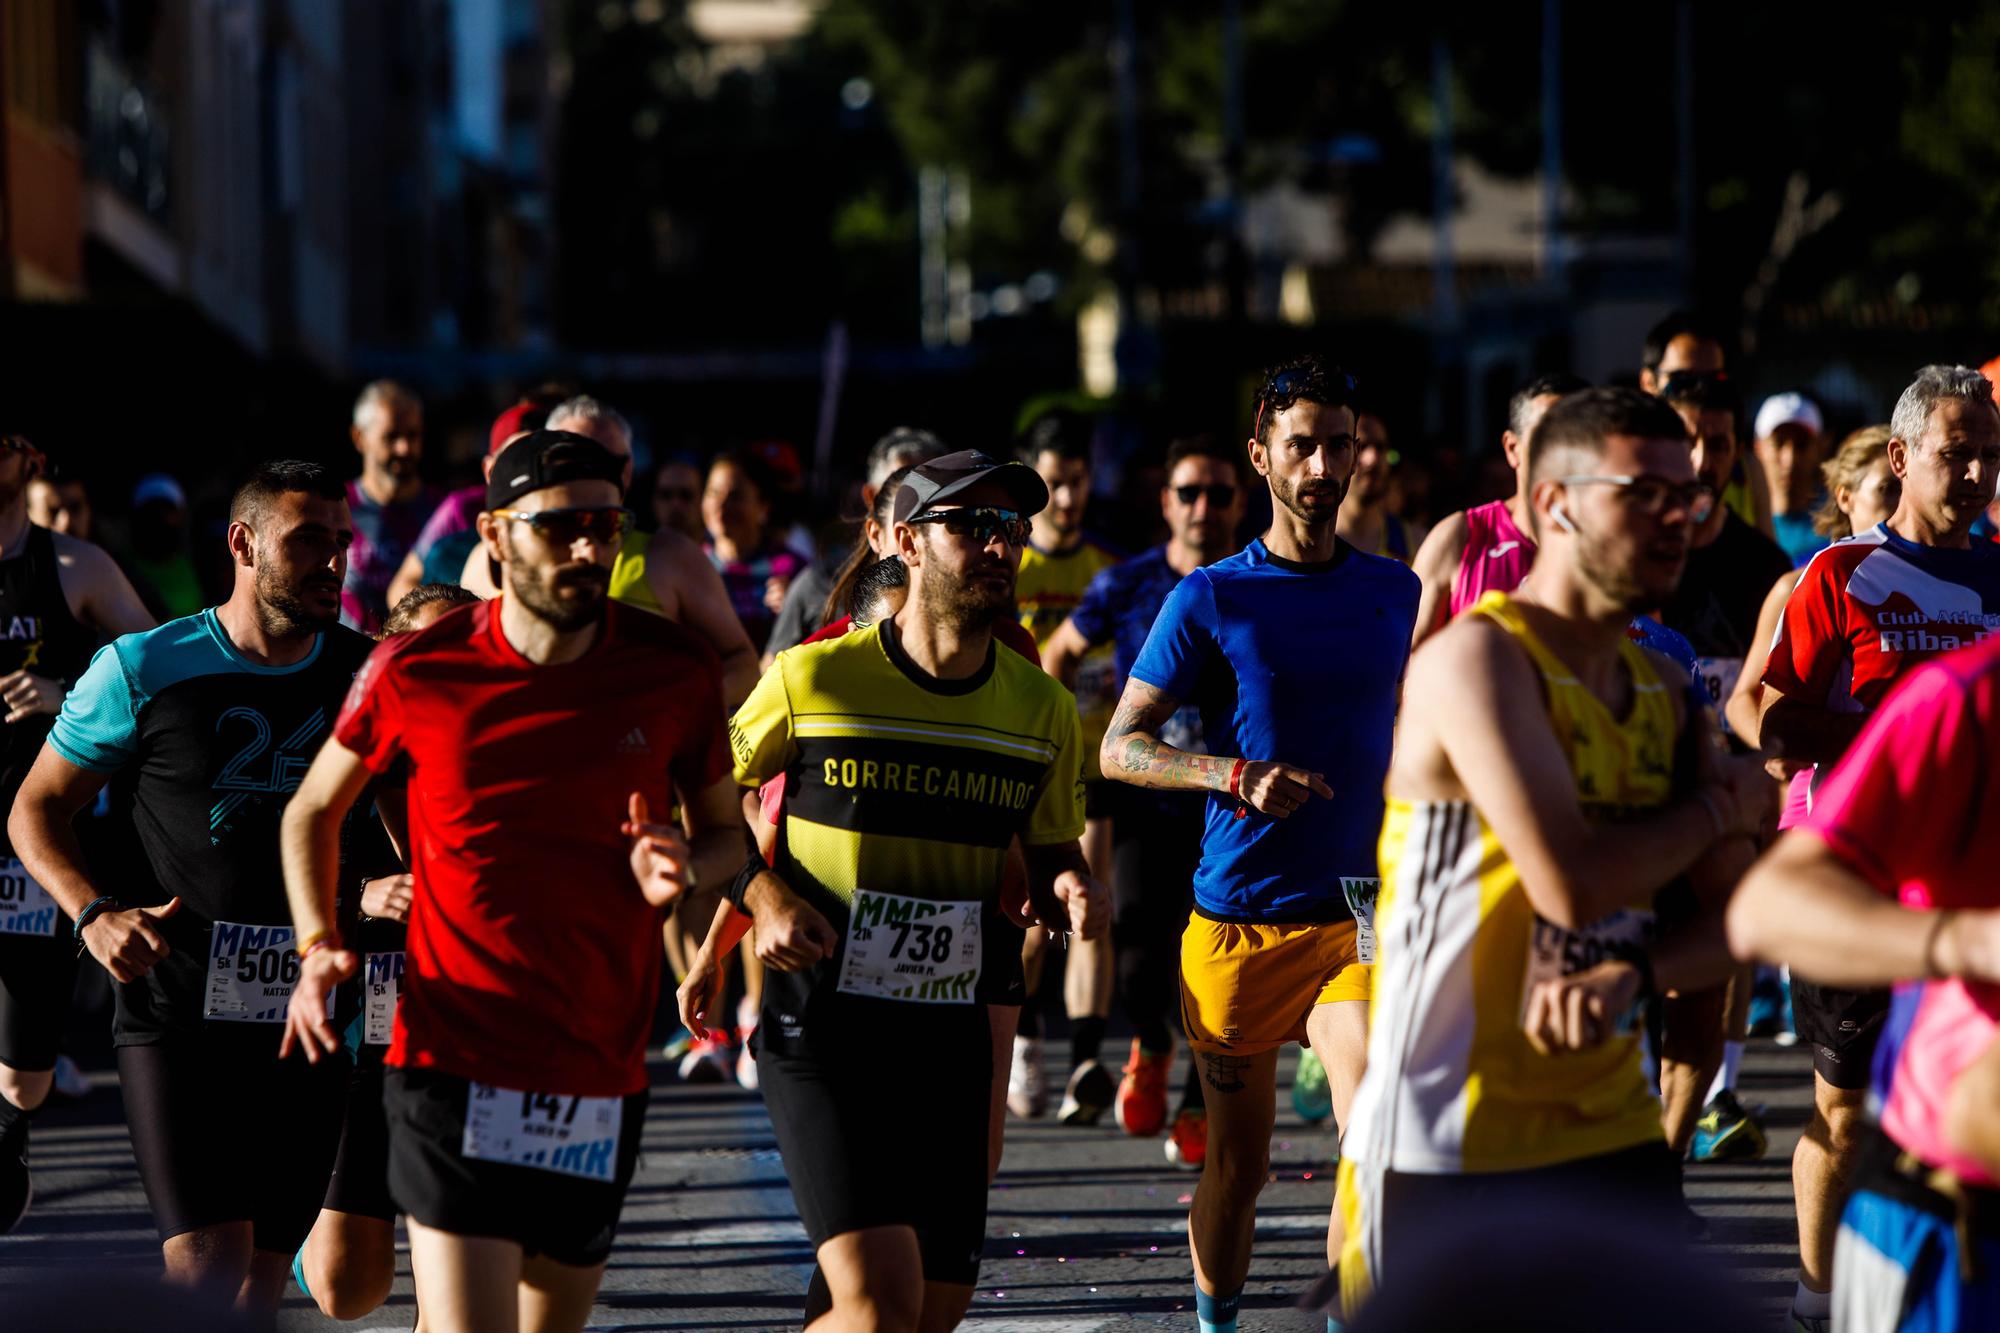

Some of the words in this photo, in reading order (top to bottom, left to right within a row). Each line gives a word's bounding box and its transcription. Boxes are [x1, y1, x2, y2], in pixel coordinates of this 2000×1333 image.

[1876, 609, 1929, 626] Club
[888, 921, 953, 963] 738
[894, 963, 924, 974] JAVIER
